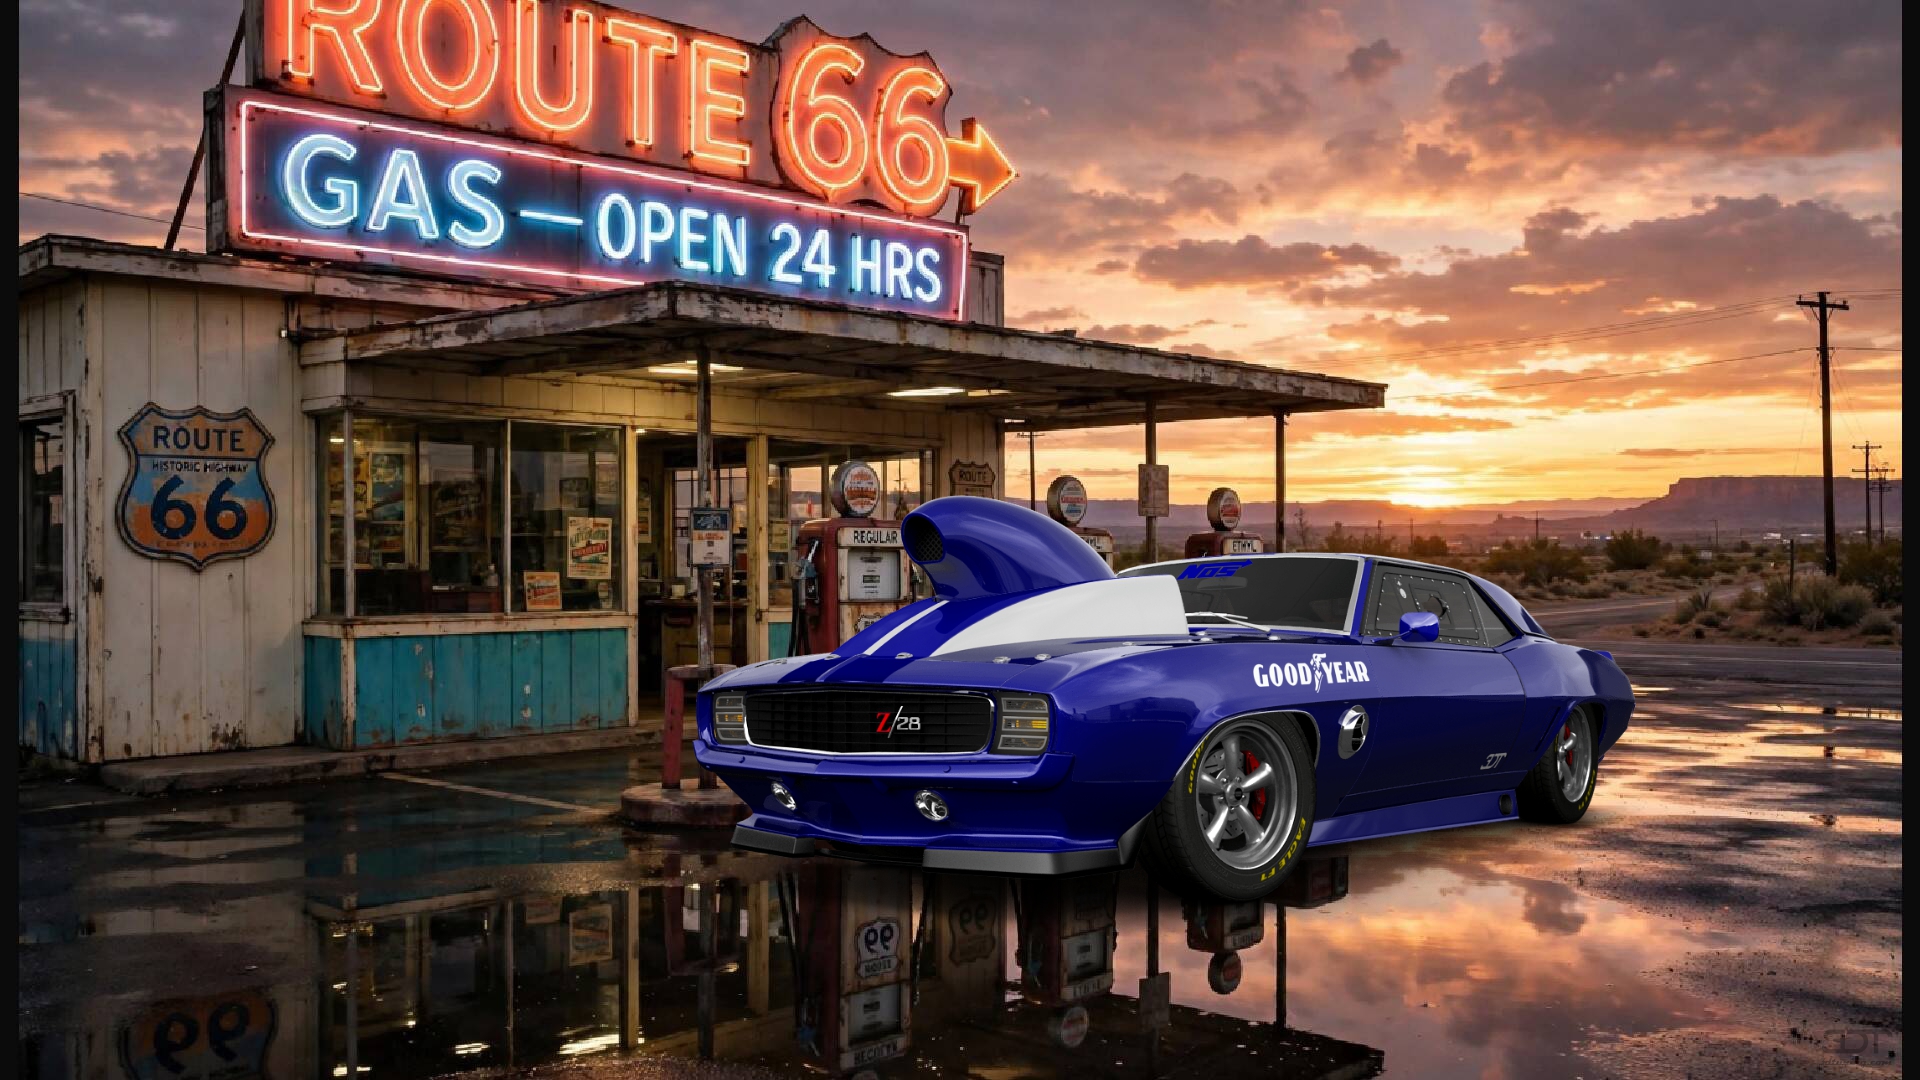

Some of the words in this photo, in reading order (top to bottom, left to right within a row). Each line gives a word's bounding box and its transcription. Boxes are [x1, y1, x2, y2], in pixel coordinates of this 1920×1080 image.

[286, 0, 750, 166] ROUTE
[788, 42, 950, 206] 66
[282, 132, 504, 249] GAS
[597, 192, 748, 277] OPEN
[769, 222, 836, 289] 24
[850, 233, 943, 303] HRS
[153, 425, 246, 452] ROUTE
[152, 460, 201, 473] HISTORIC
[203, 463, 249, 473] HIGHWAY
[959, 469, 989, 484] ROUTE
[152, 474, 248, 540] 66
[853, 530, 898, 544] REGULAR
[1177, 561, 1252, 580] NOS
[876, 705, 921, 739] Z/28
[1278, 817, 1306, 871] EAGLE
[1260, 866, 1277, 882] F1
